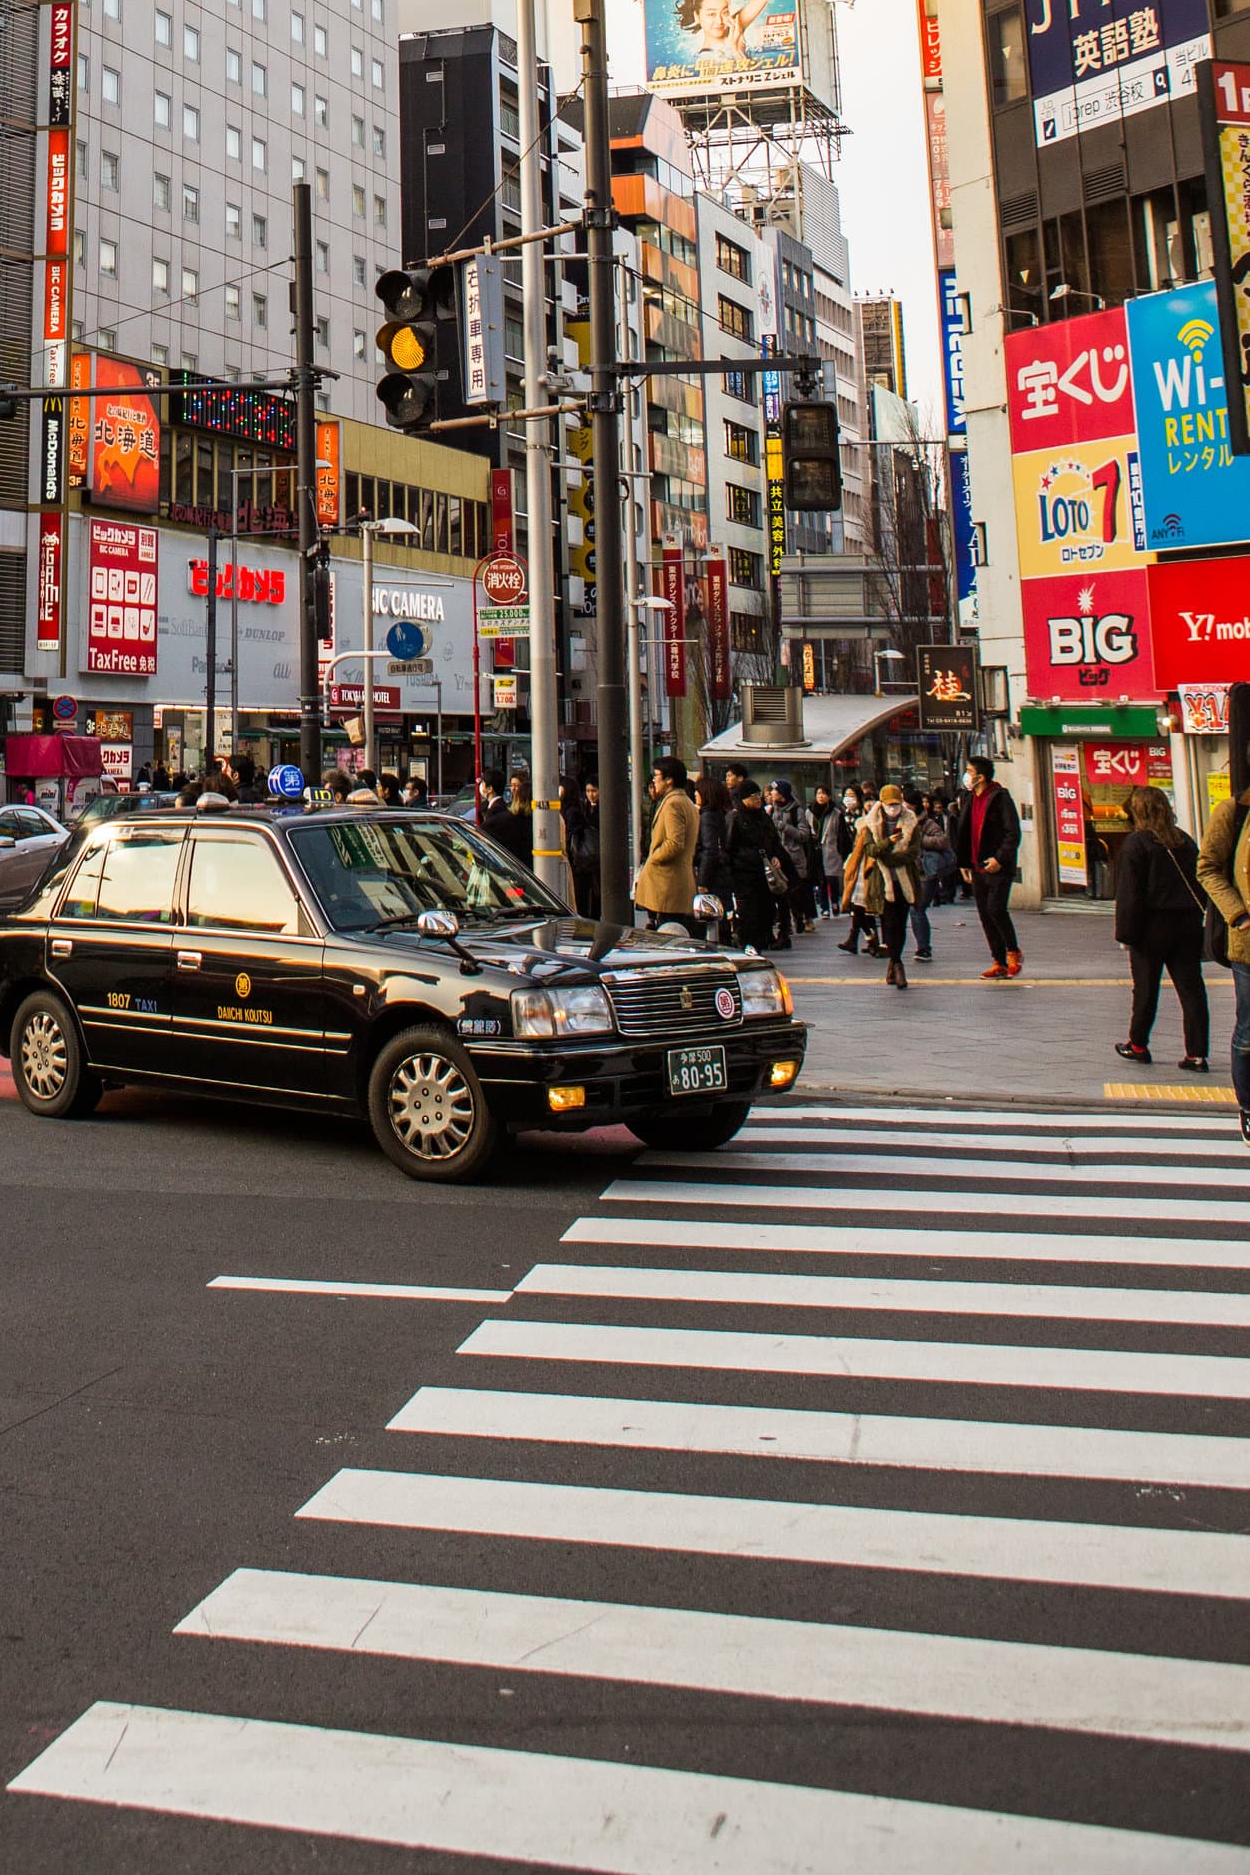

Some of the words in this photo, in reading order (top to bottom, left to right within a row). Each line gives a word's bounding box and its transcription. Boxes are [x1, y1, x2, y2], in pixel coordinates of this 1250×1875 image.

[53, 7, 69, 64] カラオケ
[50, 286, 61, 333] CAMERA
[466, 269, 485, 390] 右折車専用
[1017, 343, 1128, 420] 宝くじ
[94, 418, 158, 461] 北海道
[1168, 442, 1235, 475] レンタル
[1038, 492, 1089, 542] LOTO
[92, 525, 136, 546] ビックカメラ
[1061, 544, 1105, 563] ロトセブン
[487, 571, 521, 590] 消火栓
[391, 590, 446, 622] CAMERA
[244, 626, 286, 642] DUNLOP
[1047, 613, 1139, 666] BIG
[1093, 748, 1140, 776] 宝くじ
[106, 991, 131, 1009] 1807
[134, 997, 158, 1013] TAXI
[697, 1049, 712, 1063] 500
[681, 1065, 723, 1090] 80-95
